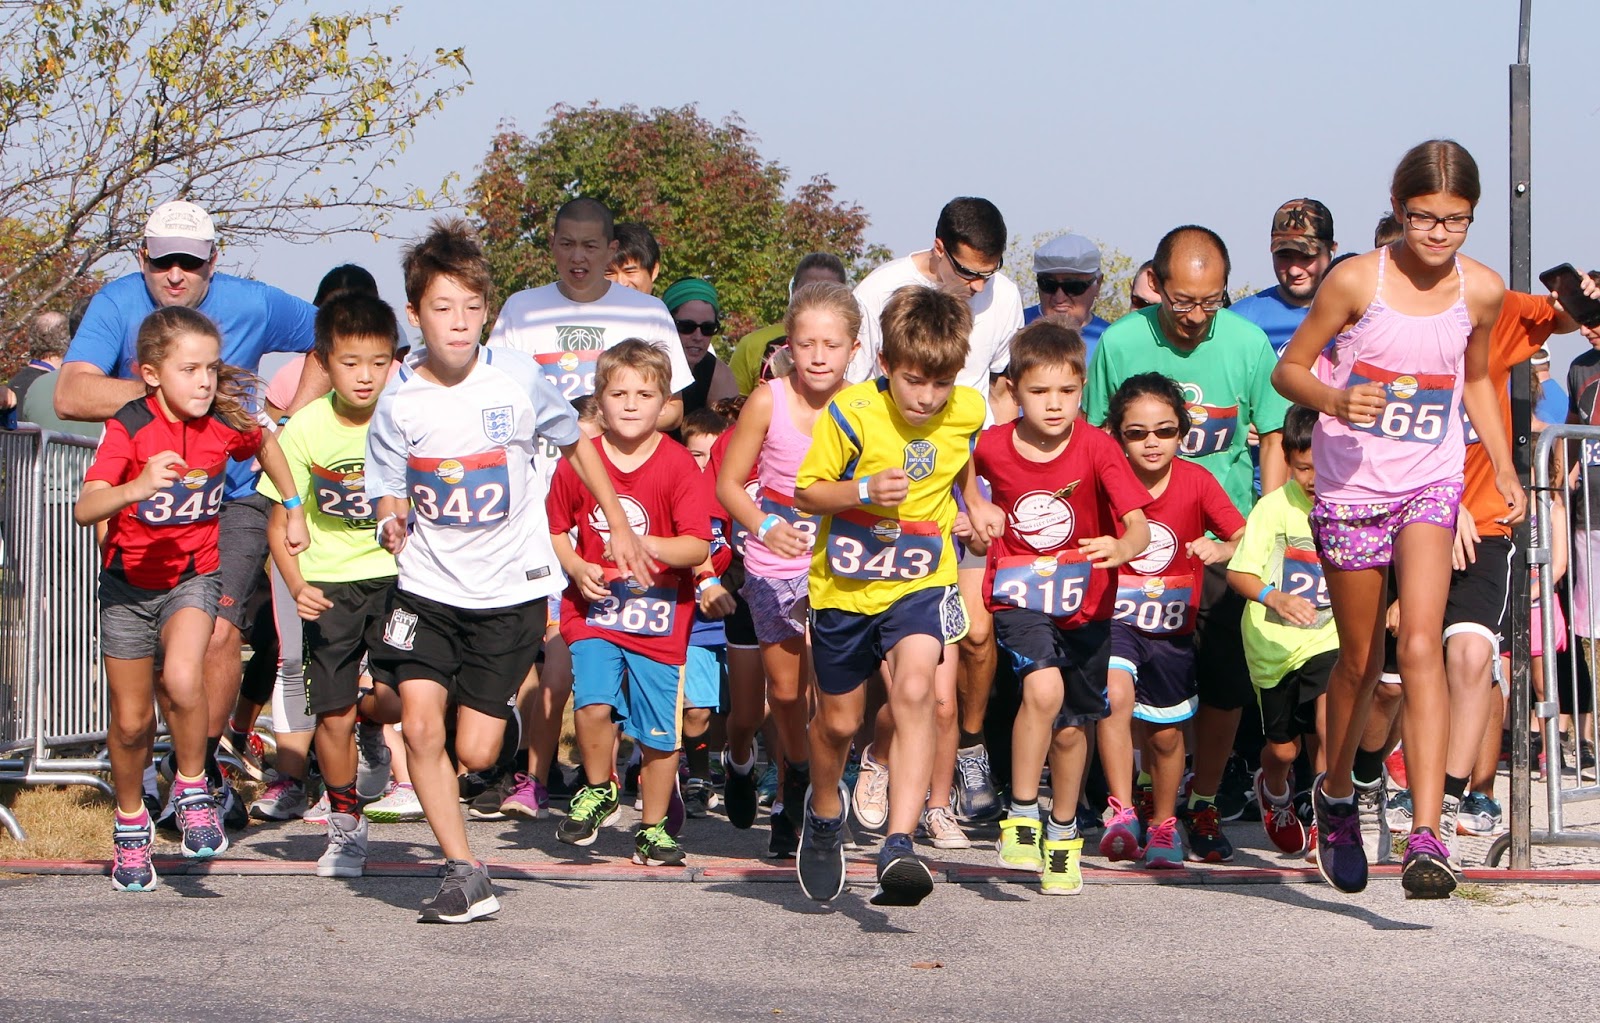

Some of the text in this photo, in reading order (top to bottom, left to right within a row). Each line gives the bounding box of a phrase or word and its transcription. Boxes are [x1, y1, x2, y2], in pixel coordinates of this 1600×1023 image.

[1180, 427, 1228, 453] 01
[145, 481, 225, 522] 349
[319, 488, 373, 517] 23
[414, 483, 504, 523] 342
[831, 536, 933, 579] 343
[1000, 577, 1085, 613] 315
[1289, 573, 1331, 604] 25
[394, 615, 416, 626] CITY
[595, 596, 671, 633] 363
[1112, 600, 1186, 630] 208
